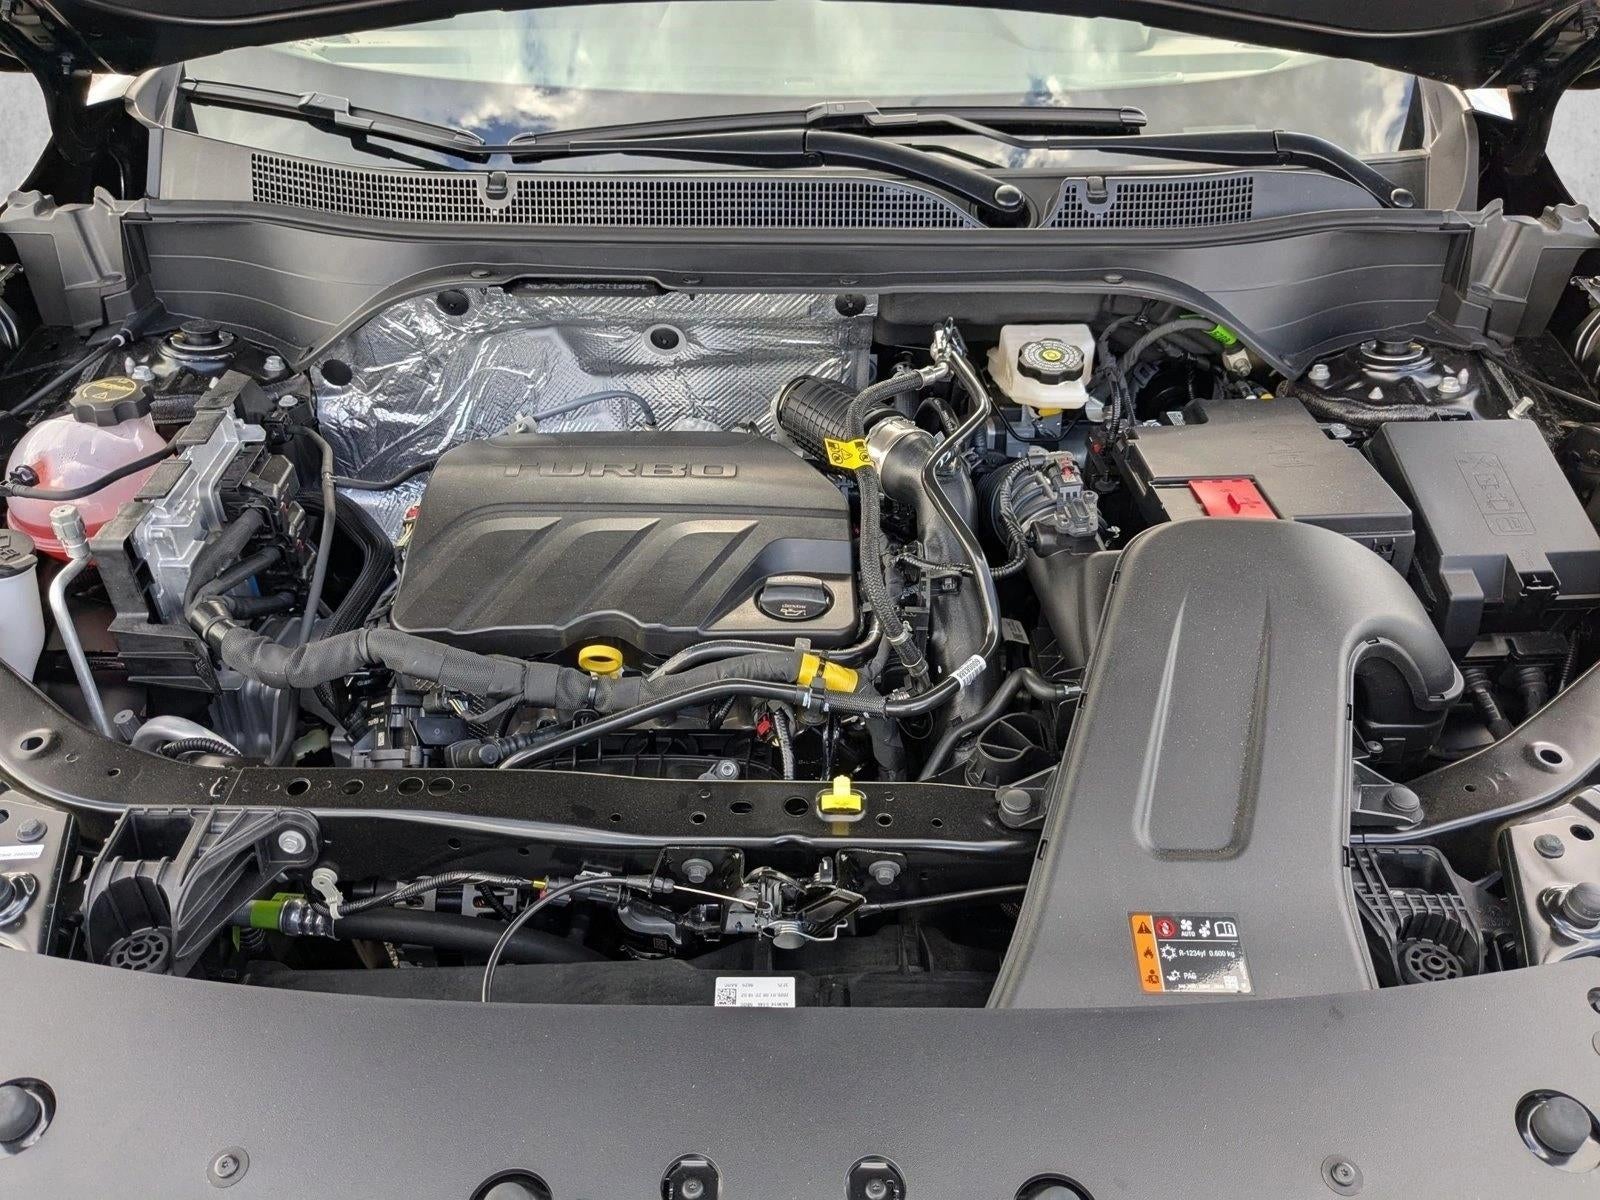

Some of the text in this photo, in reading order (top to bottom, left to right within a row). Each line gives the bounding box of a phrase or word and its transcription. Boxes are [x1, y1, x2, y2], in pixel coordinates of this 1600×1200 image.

[493, 463, 738, 478] TURBO
[1178, 949, 1206, 958] R-1234yf
[1226, 949, 1236, 958] kg
[1183, 972, 1197, 980] PAG
